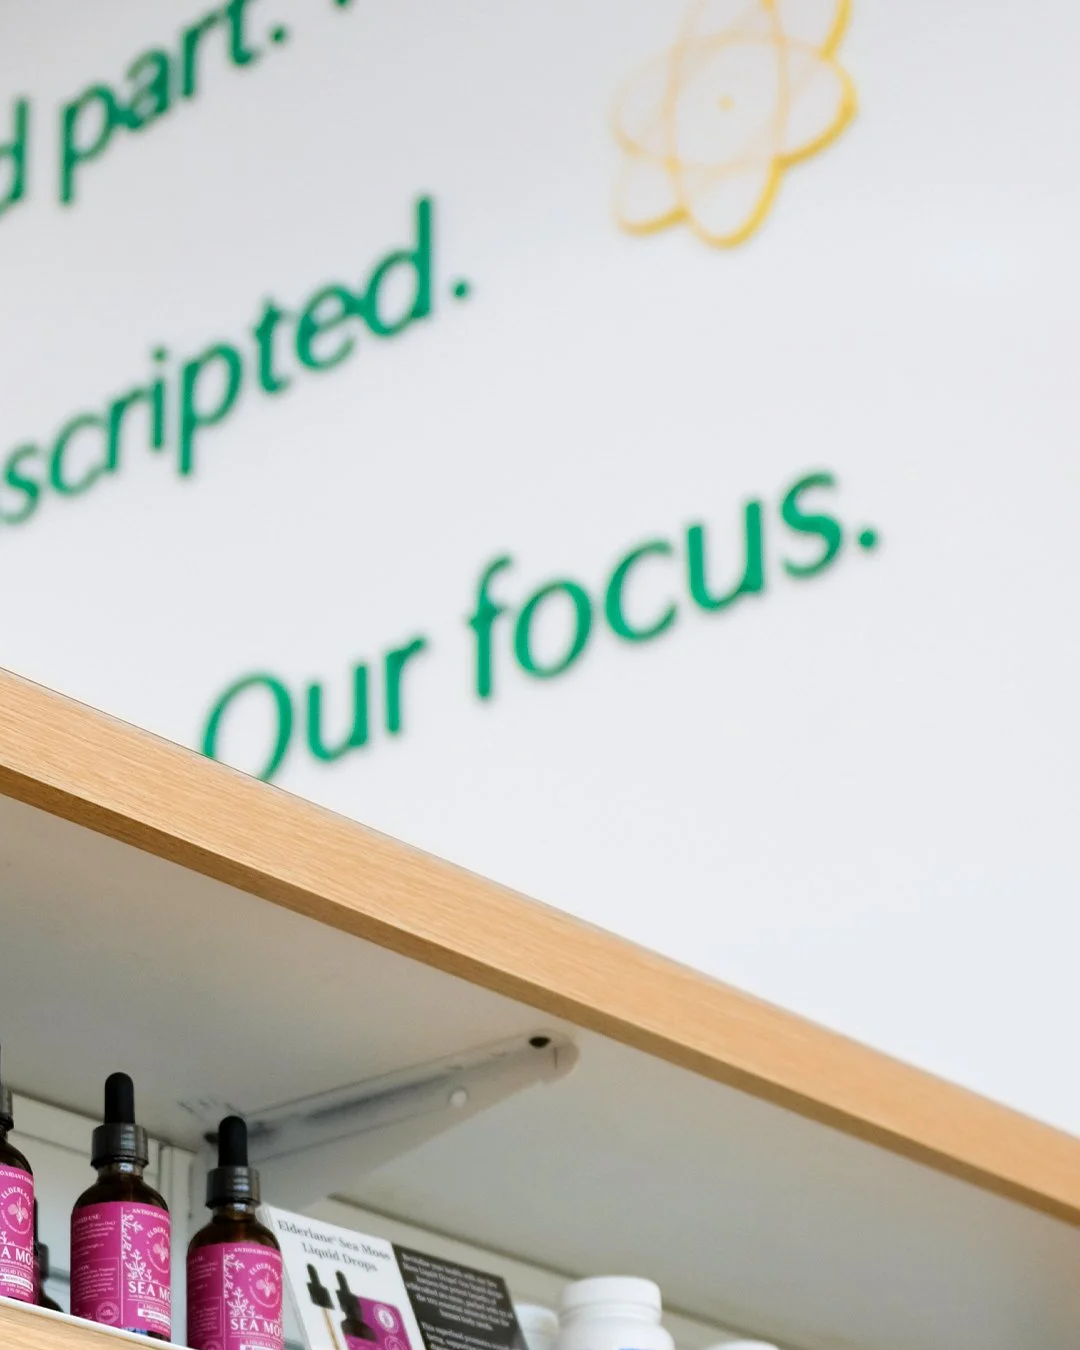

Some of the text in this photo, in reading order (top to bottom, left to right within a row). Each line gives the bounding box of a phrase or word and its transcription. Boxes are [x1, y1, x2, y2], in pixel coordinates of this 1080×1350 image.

[59, 0, 288, 205] part.
[201, 470, 880, 782] Our focus.
[301, 1242, 377, 1272] Liquid Drops
[339, 1237, 359, 1252] Sea
[361, 1244, 391, 1260] Moss
[128, 1281, 155, 1297] SEA
[231, 1318, 259, 1332] SEA
